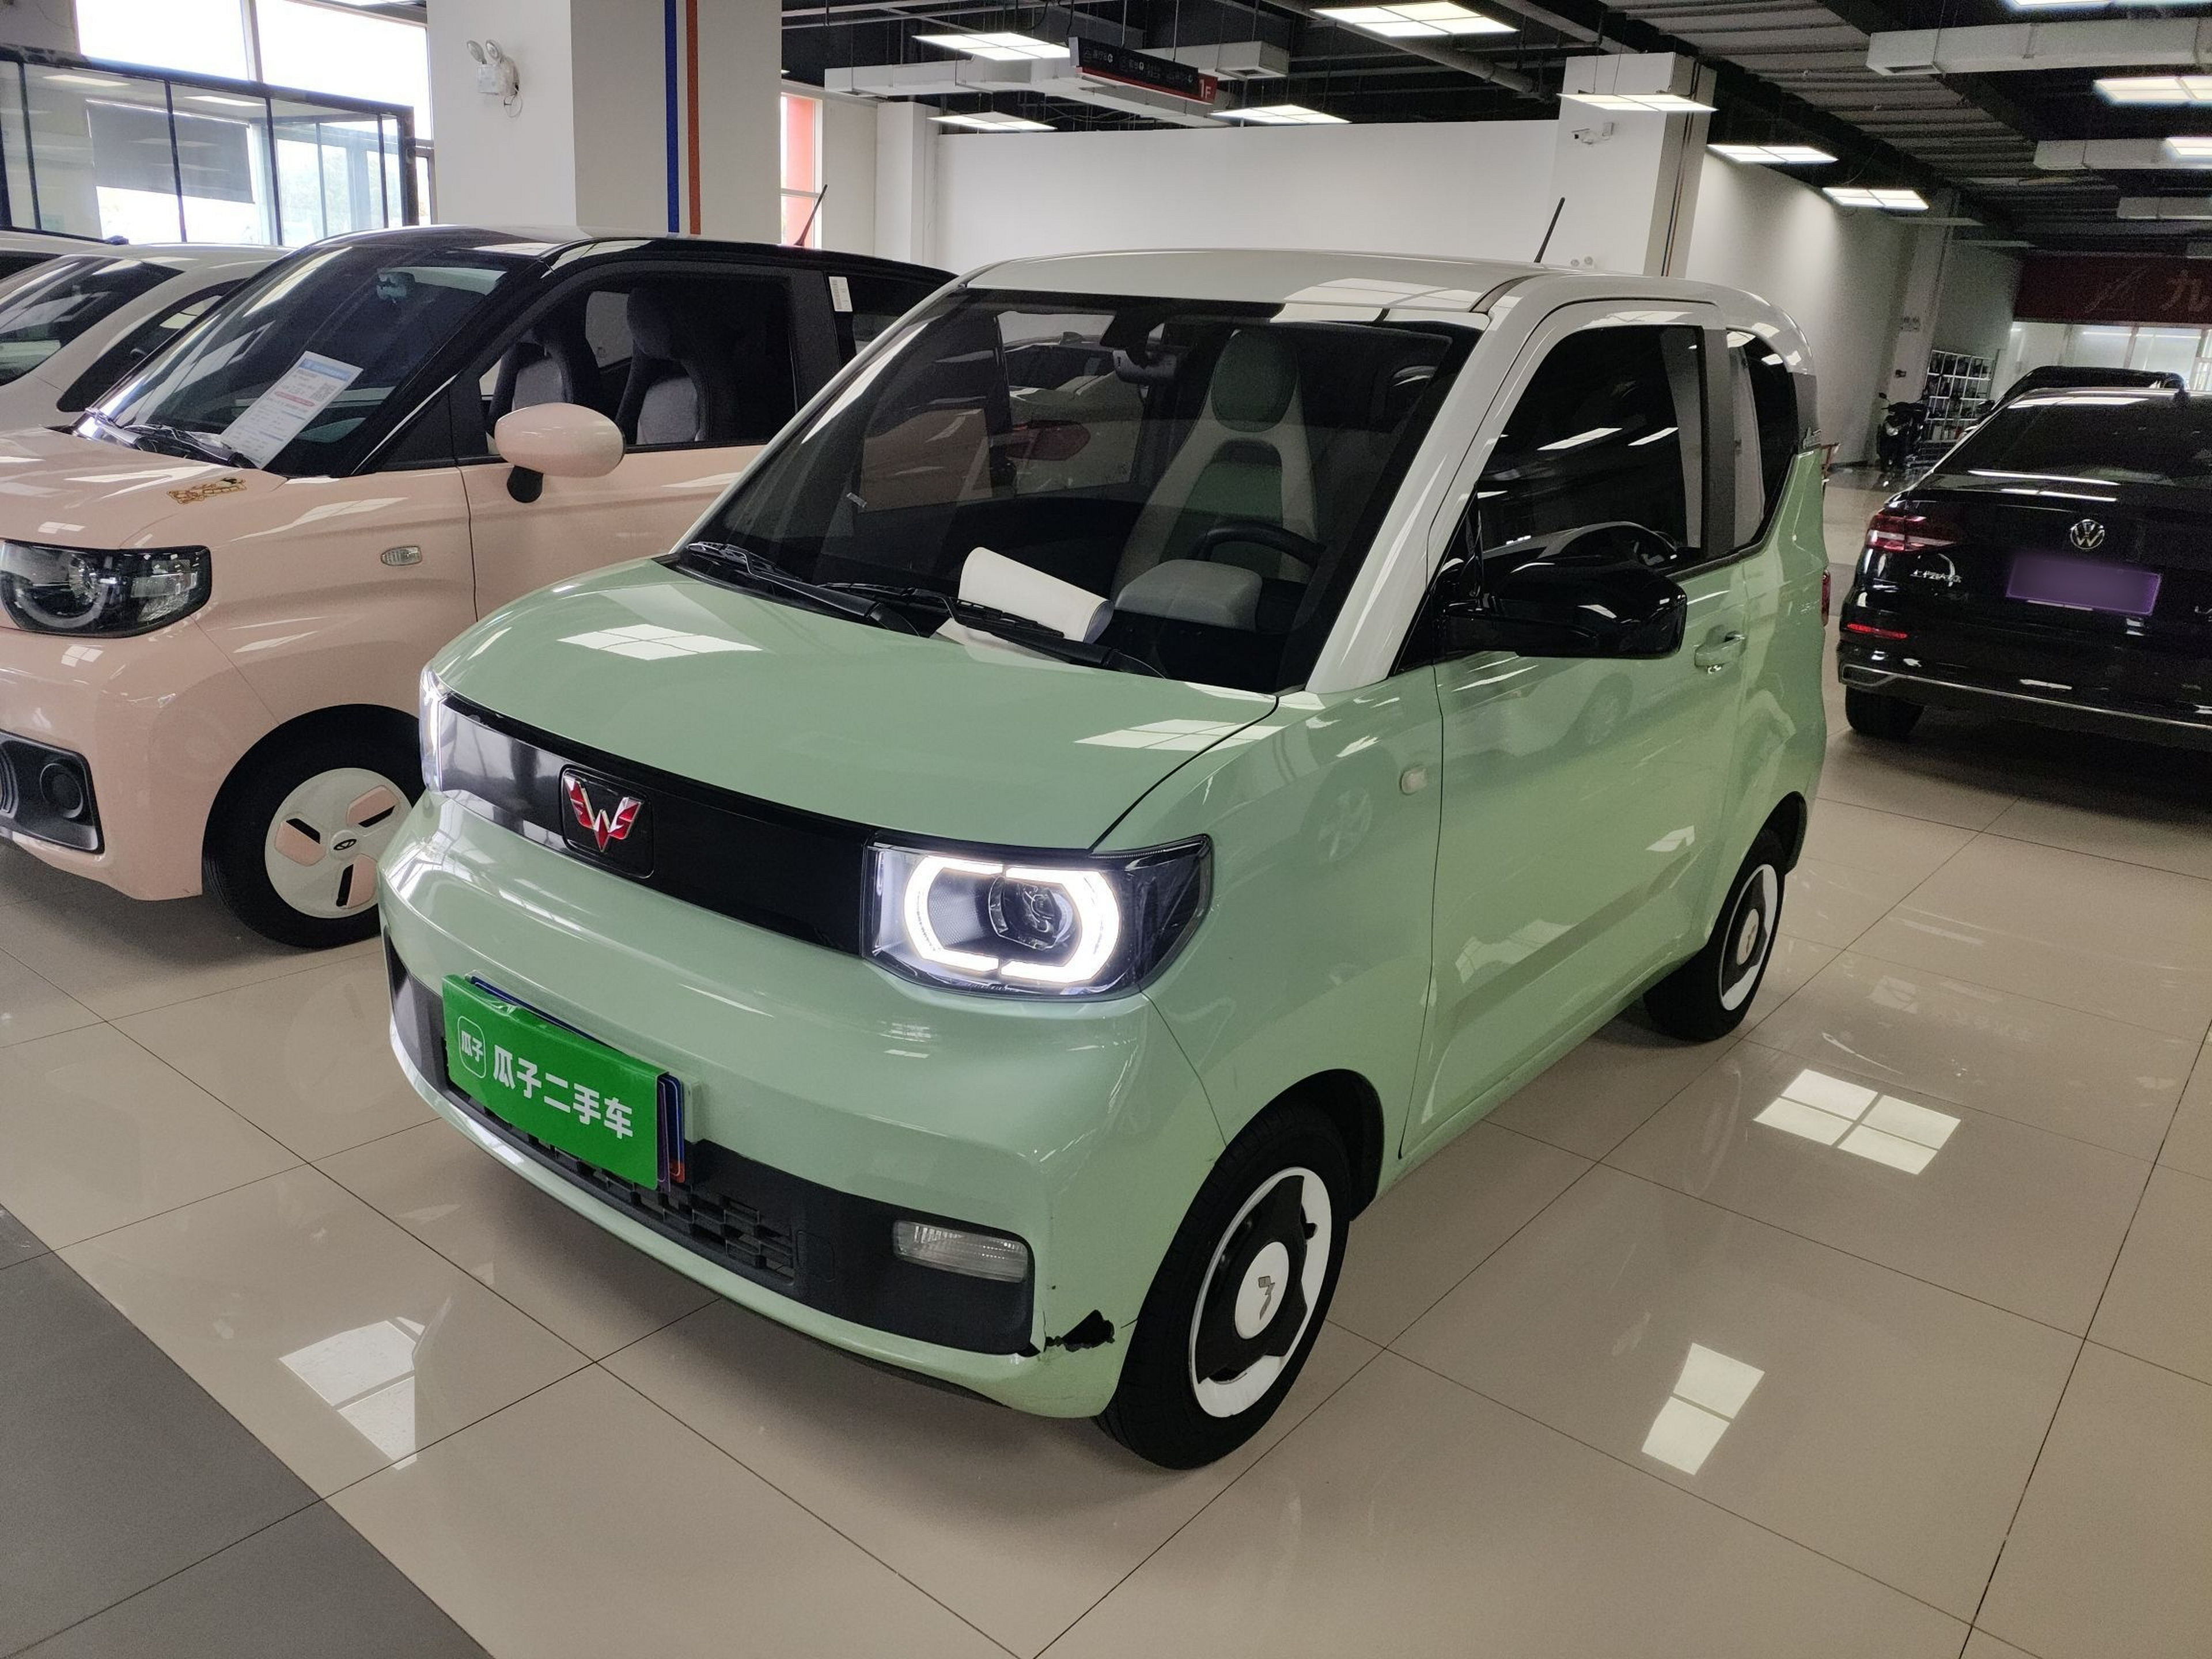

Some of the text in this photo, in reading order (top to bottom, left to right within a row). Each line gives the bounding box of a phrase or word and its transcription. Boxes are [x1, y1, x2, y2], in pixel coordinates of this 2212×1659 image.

[1200, 79, 1211, 99] 1F
[461, 1029, 483, 1062] 瓜子
[493, 1044, 633, 1139] 瓜子二手车
